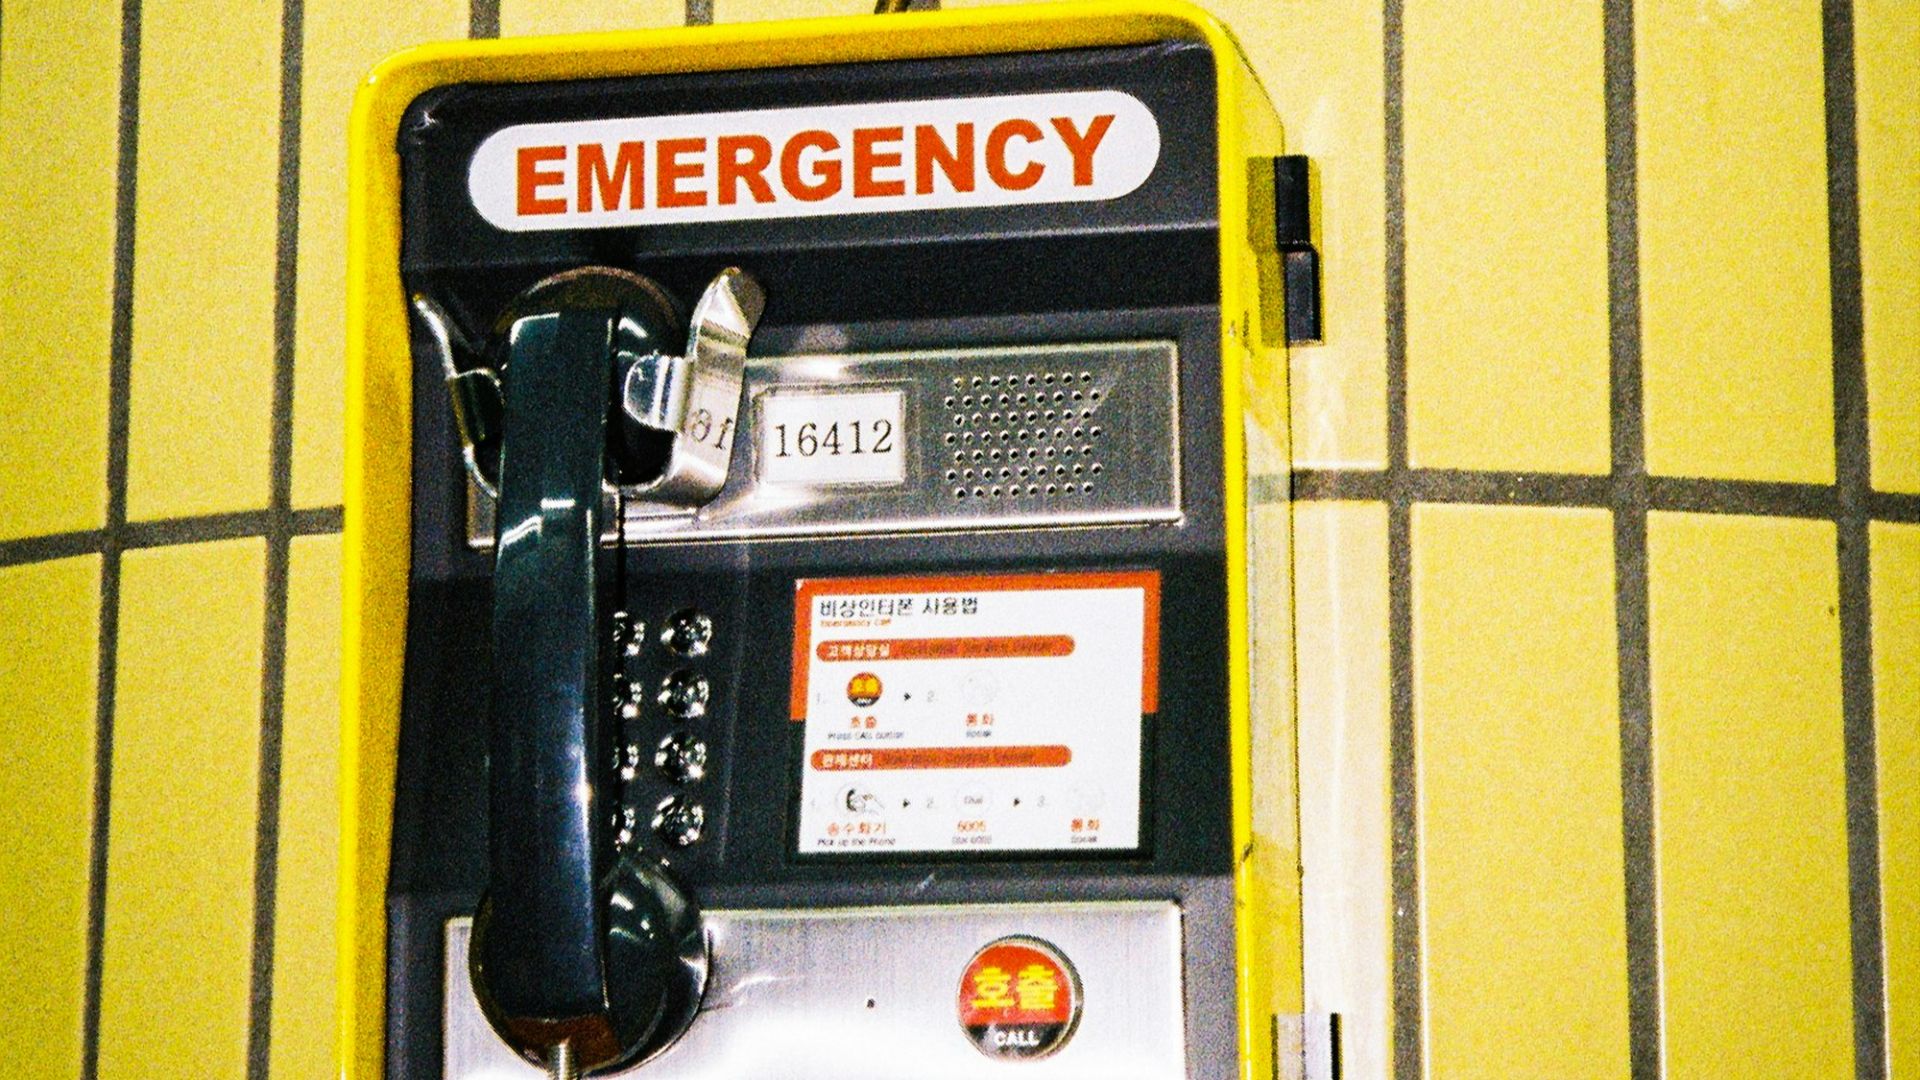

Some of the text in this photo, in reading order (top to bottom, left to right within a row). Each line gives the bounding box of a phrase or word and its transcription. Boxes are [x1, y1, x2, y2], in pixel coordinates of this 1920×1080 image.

[515, 114, 1116, 217] EMERGENCY
[774, 418, 894, 458] 16412
[820, 596, 978, 618] 비상인터폰 사용법
[970, 964, 1059, 1010] 호출
[993, 1029, 1040, 1046] CALL
